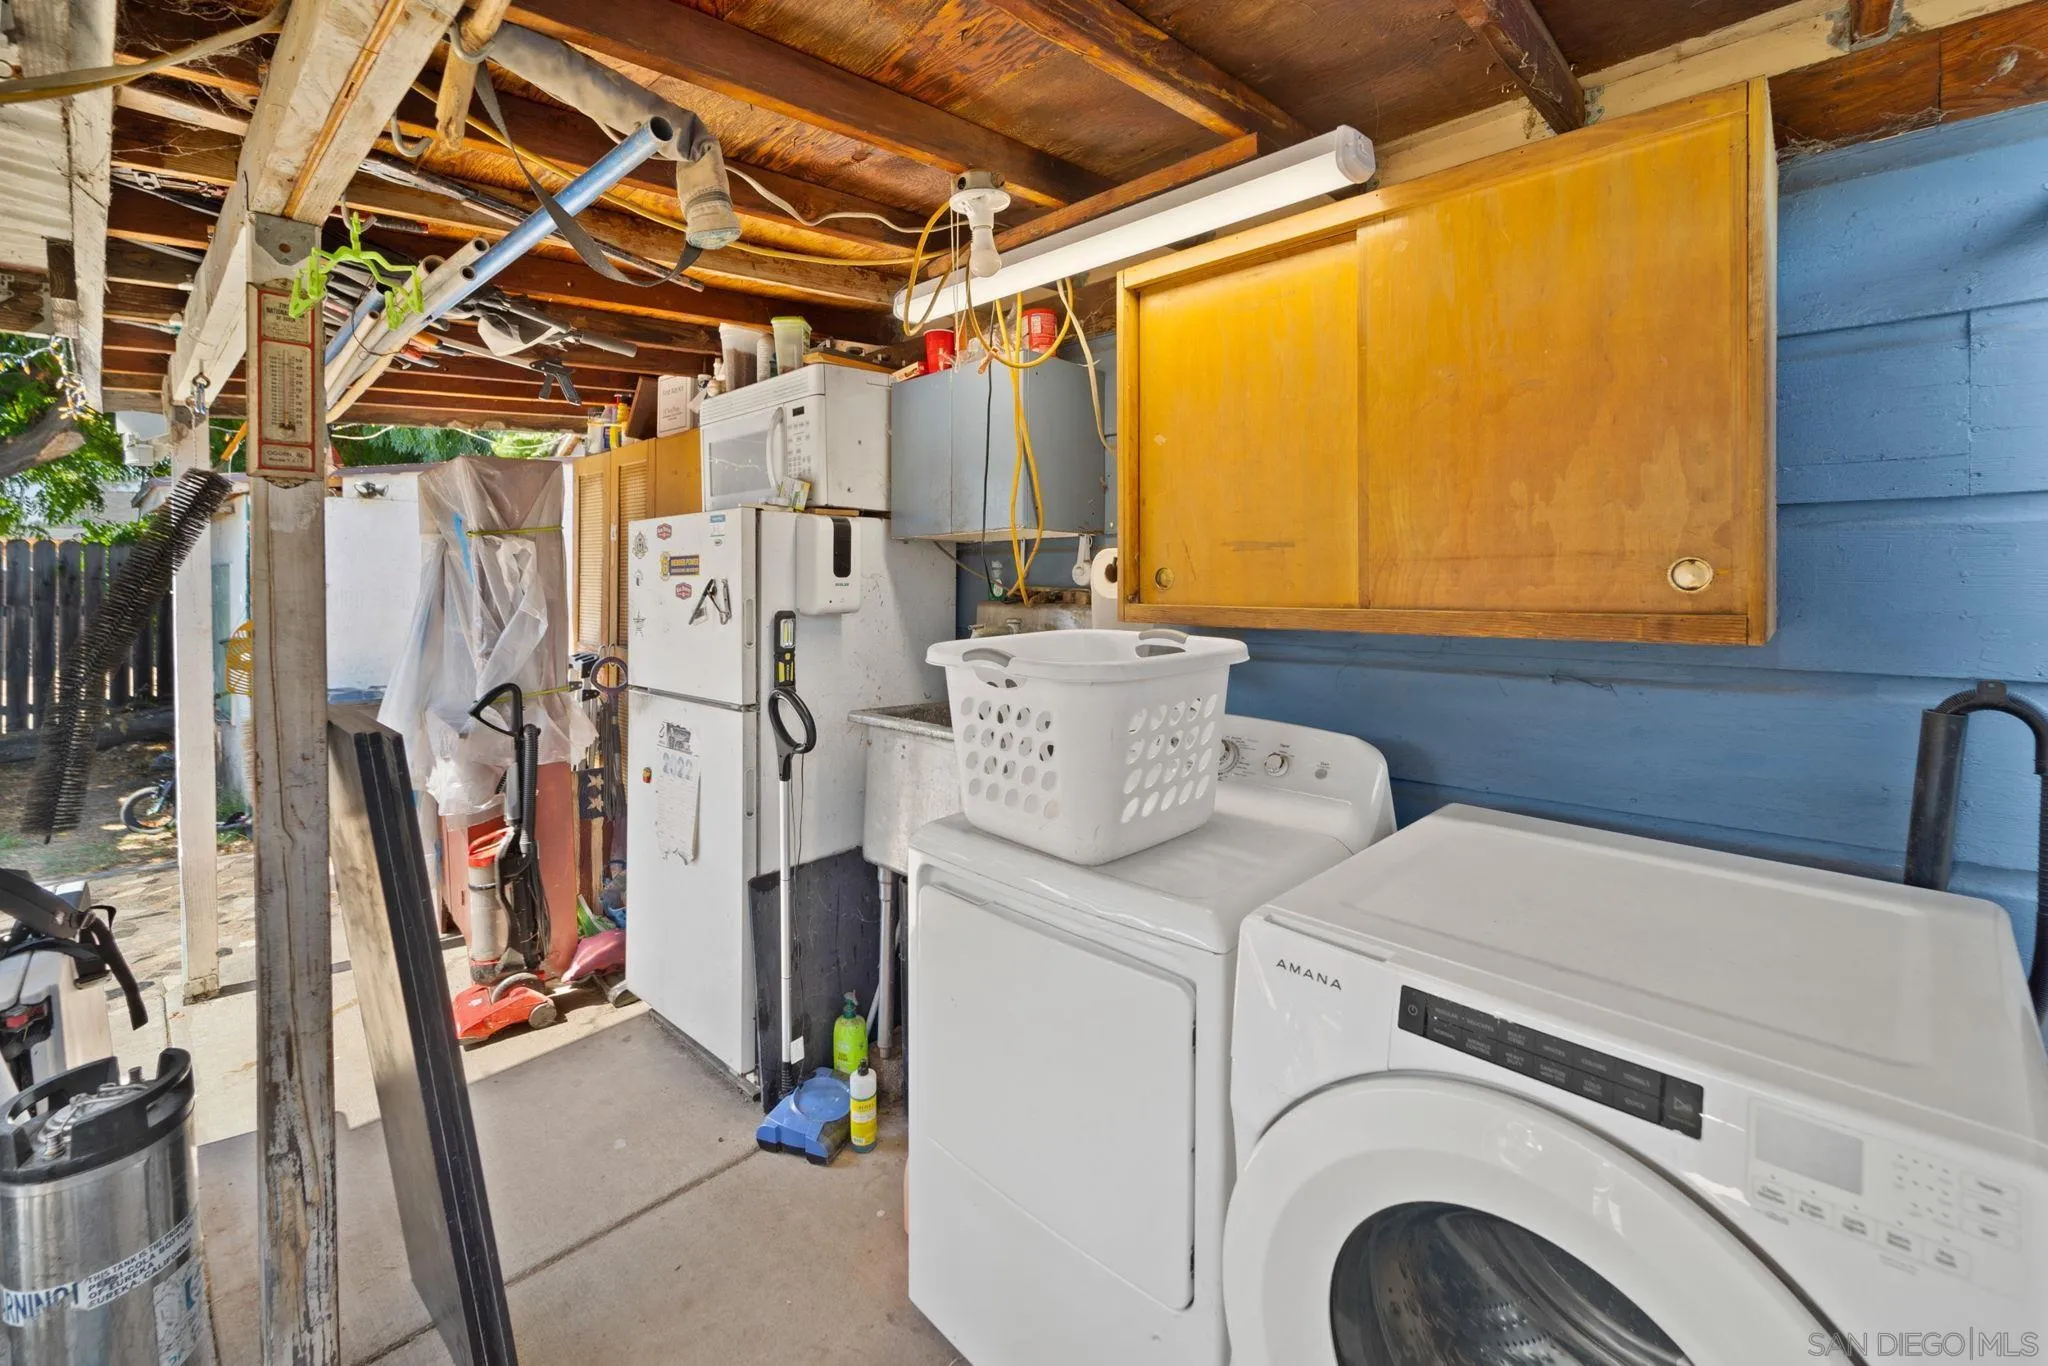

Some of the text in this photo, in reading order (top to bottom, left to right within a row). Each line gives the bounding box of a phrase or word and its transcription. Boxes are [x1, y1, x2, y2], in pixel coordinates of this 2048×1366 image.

[1276, 959, 1342, 991] AMANA
[87, 1270, 111, 1284] THIS
[113, 1257, 136, 1272] TANK
[88, 1262, 154, 1300] OF EUREKA
